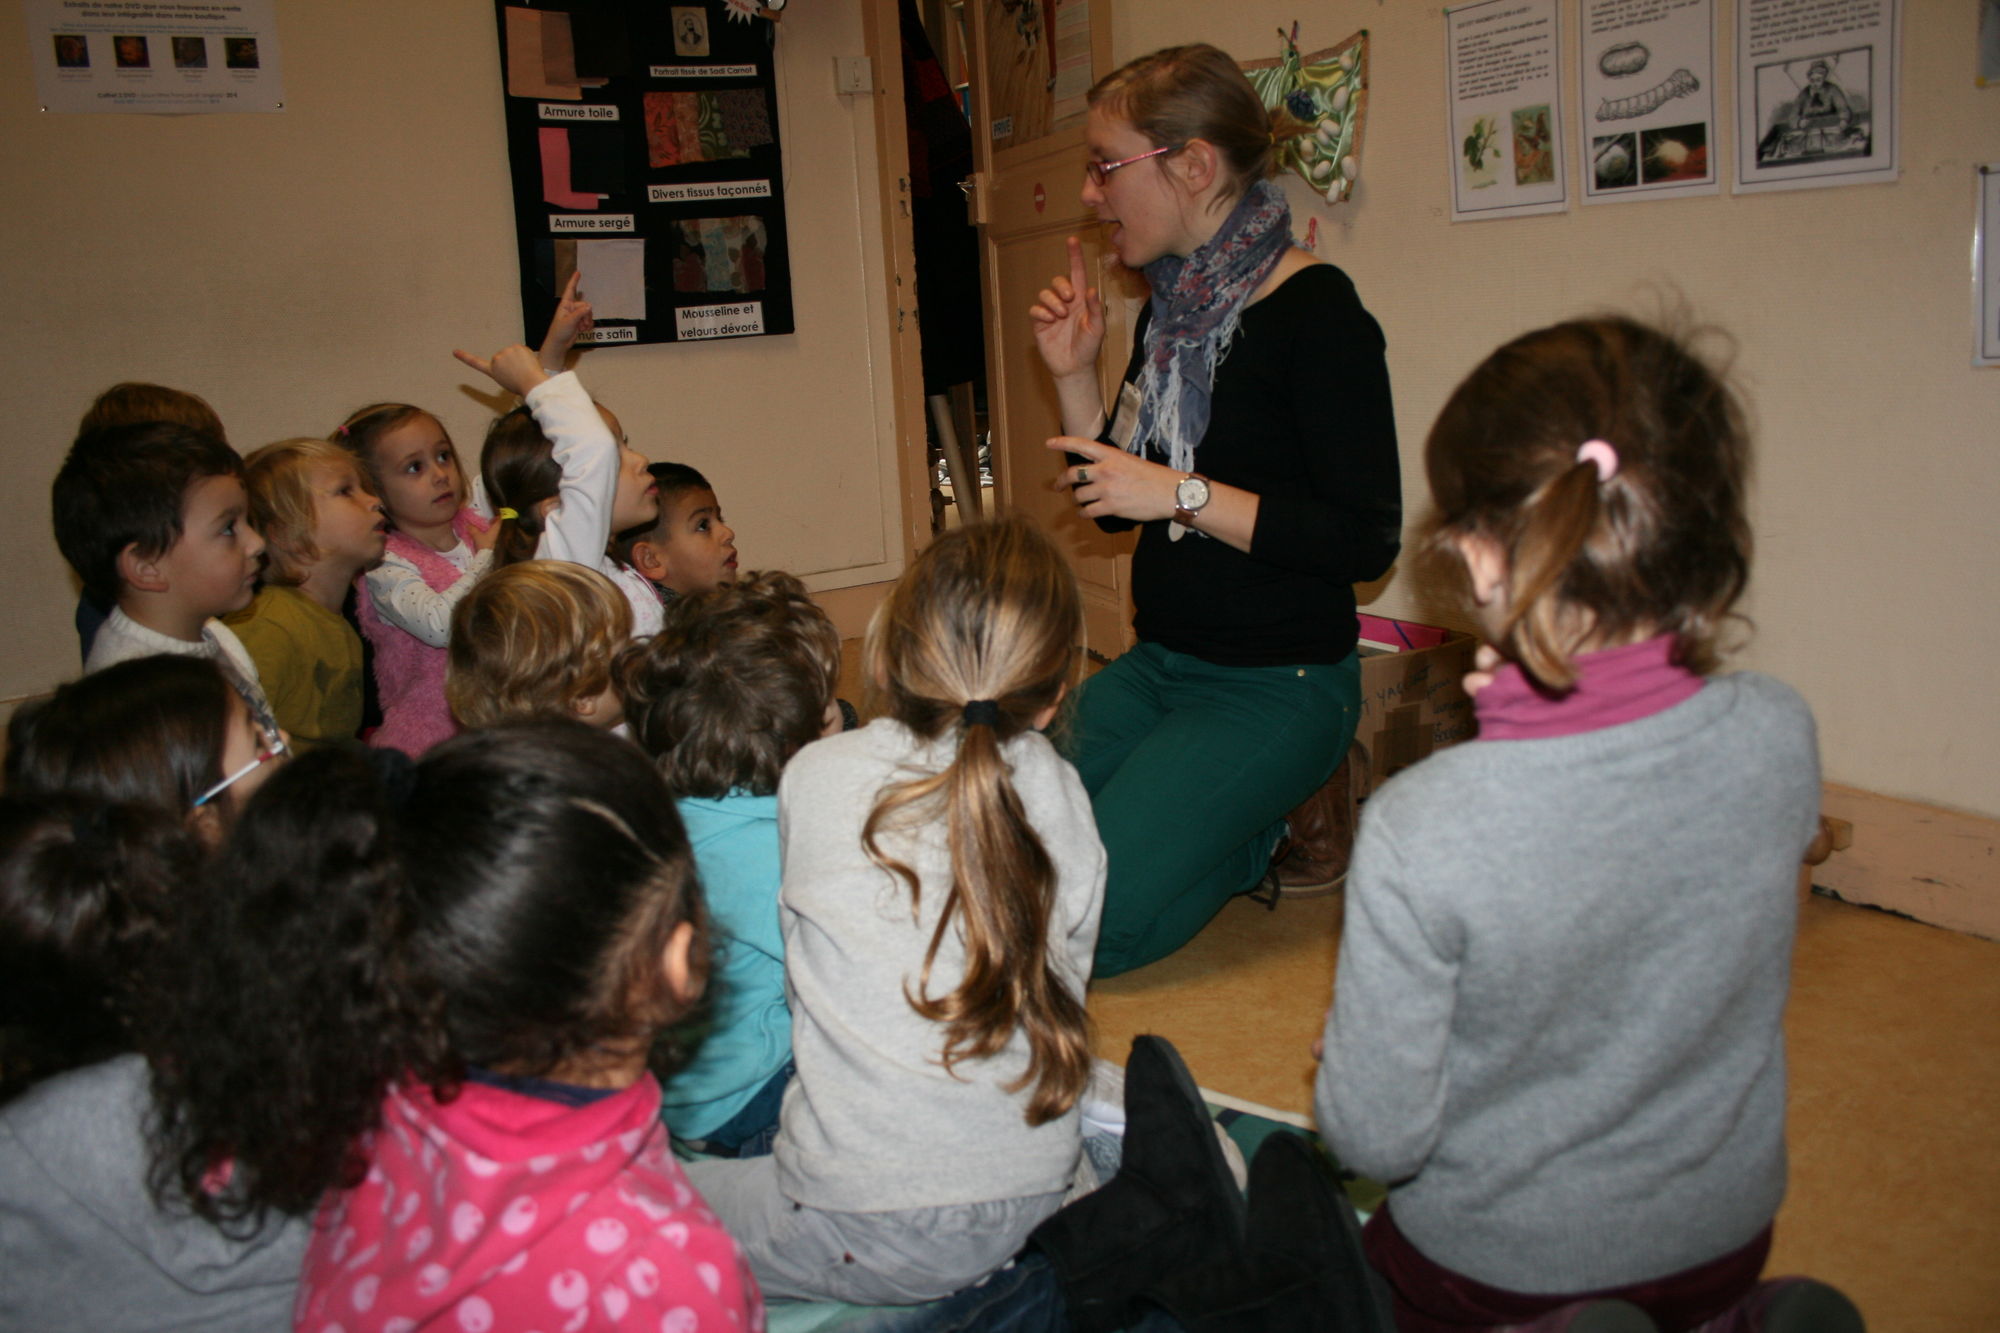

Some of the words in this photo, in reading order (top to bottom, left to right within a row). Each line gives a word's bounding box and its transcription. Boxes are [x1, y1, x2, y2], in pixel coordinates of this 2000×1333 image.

[124, 2, 141, 10] DVD
[698, 67, 708, 75] de
[710, 67, 726, 75] Sadi
[727, 66, 753, 74] Carnot
[544, 106, 586, 118] Armure
[588, 107, 613, 118] toile
[652, 189, 685, 199] Divers
[687, 187, 715, 198] tissus
[717, 183, 768, 197] façonnés
[554, 218, 595, 228] Armure
[598, 216, 630, 230] sergé
[682, 305, 740, 319] Mousseline
[743, 304, 754, 314] et
[606, 329, 633, 340] satin
[680, 327, 718, 338] velours
[720, 320, 759, 335] dévoré
